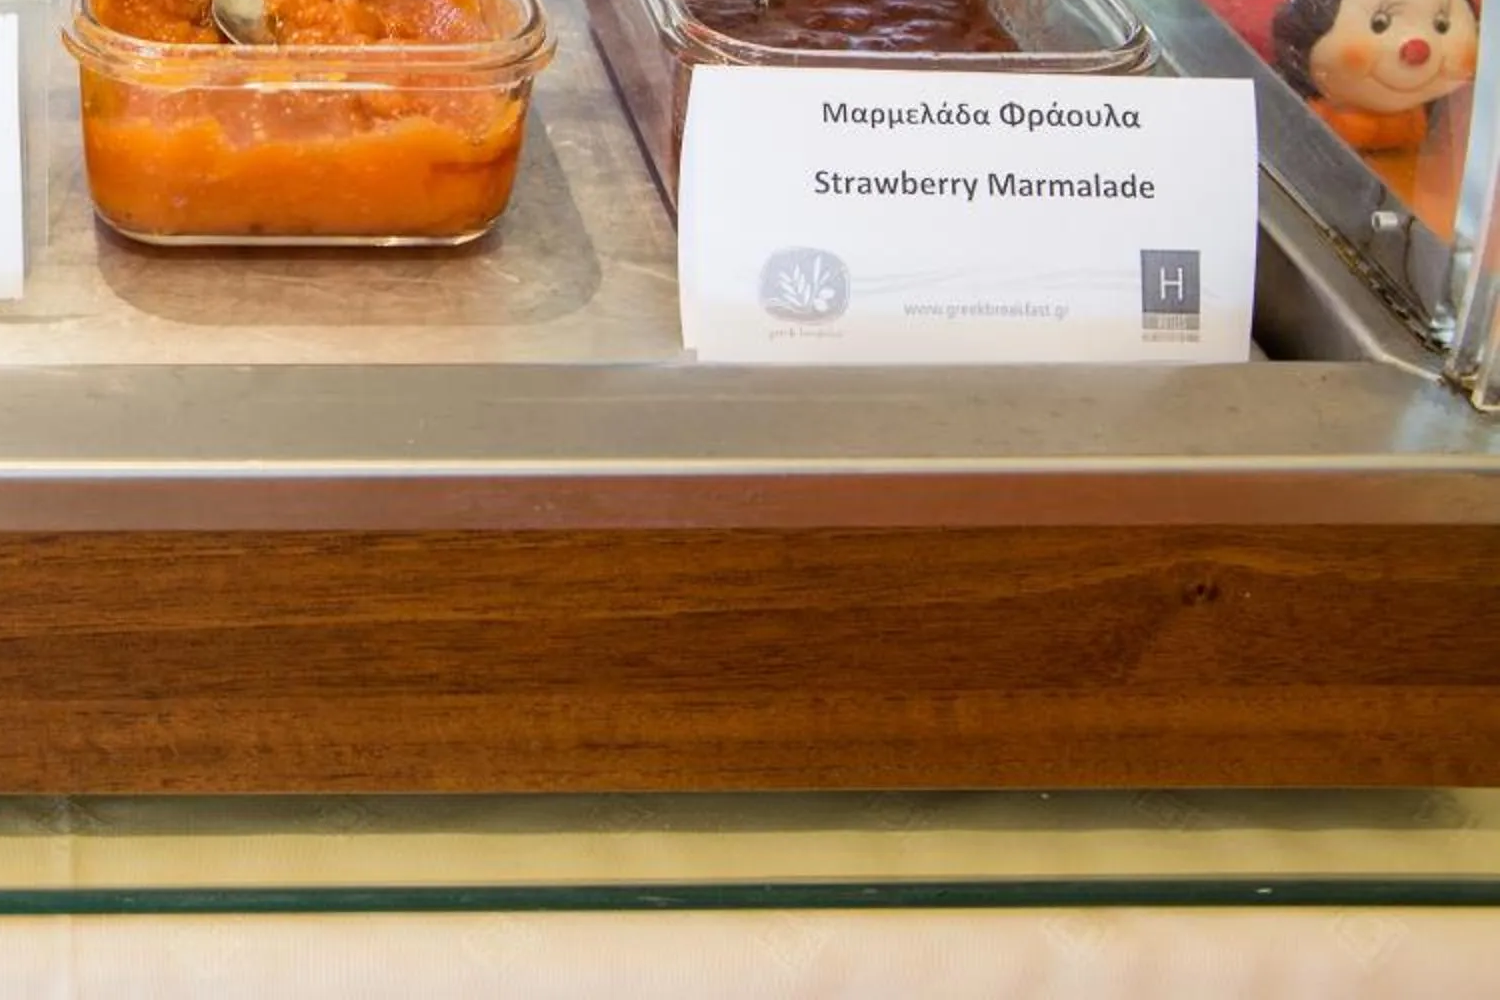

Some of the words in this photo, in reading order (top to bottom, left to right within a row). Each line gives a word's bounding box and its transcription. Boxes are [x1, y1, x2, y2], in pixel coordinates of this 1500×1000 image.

[821, 101, 991, 130] Μαρμελάδα
[998, 98, 1142, 132] Φράουλα
[814, 169, 979, 202] Strawberry
[988, 171, 1156, 200] Marmalade
